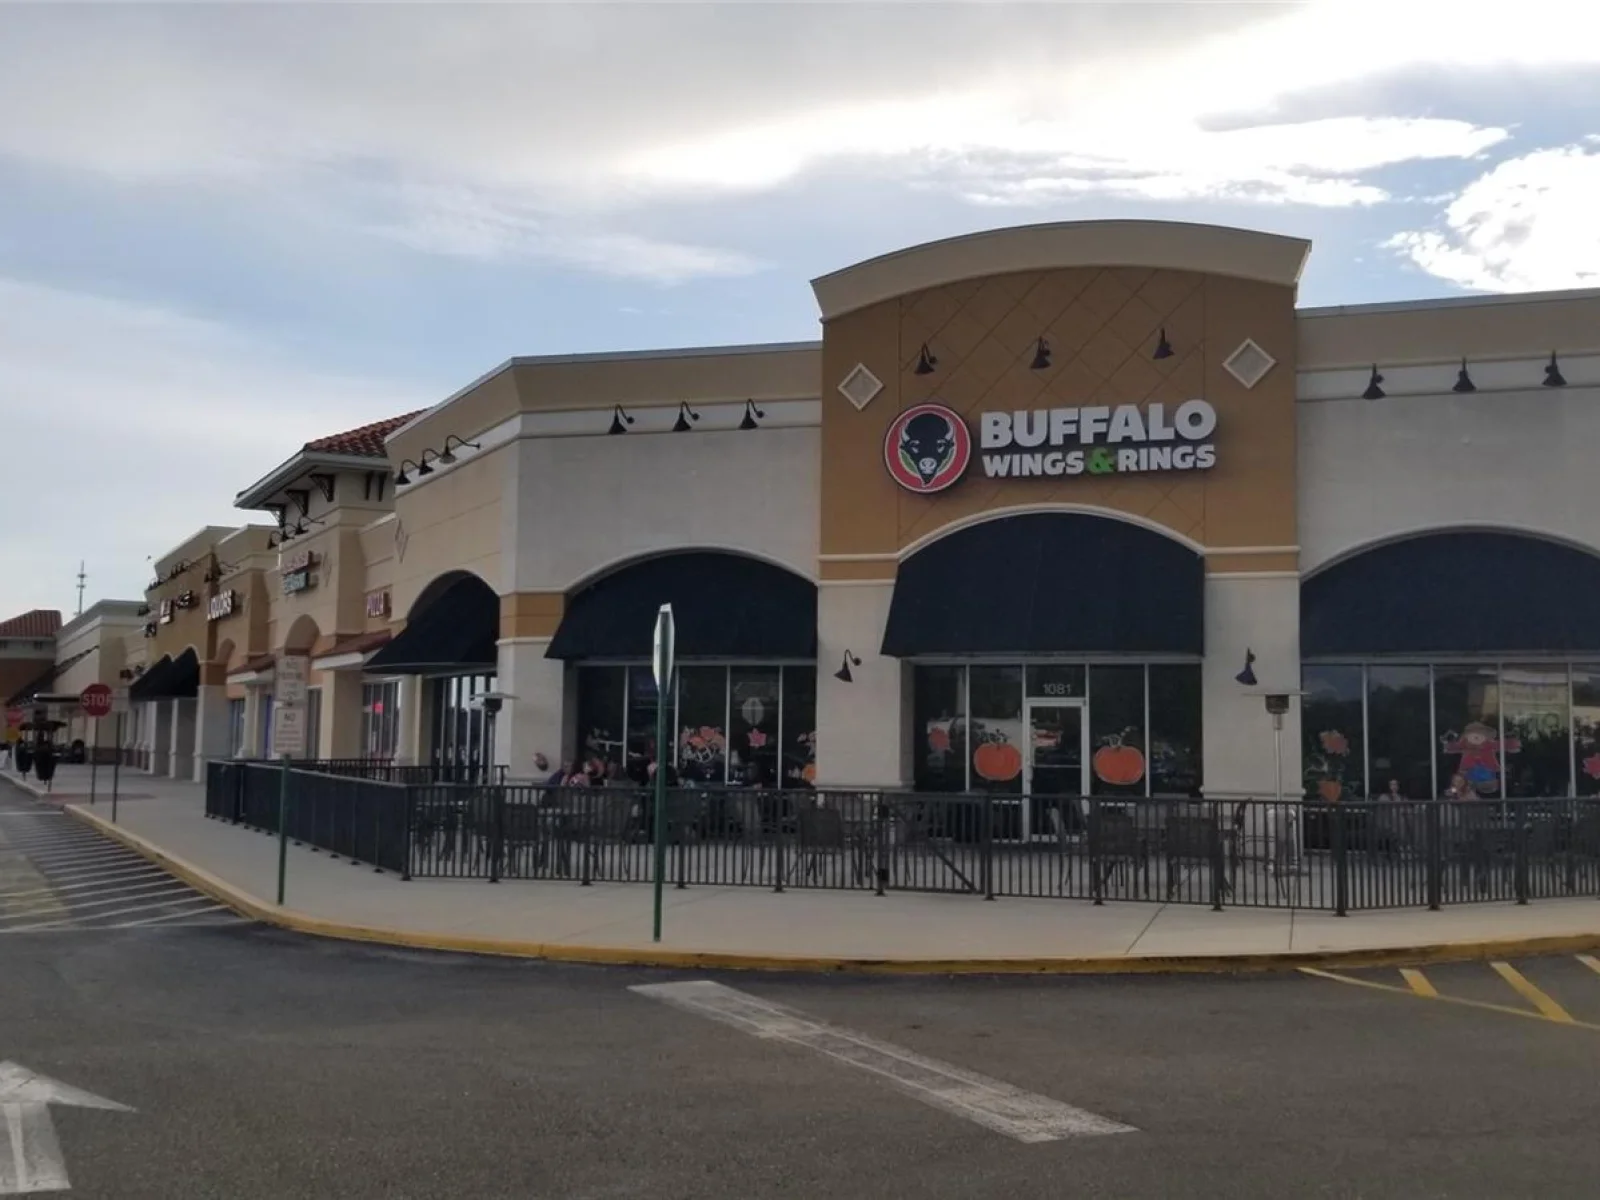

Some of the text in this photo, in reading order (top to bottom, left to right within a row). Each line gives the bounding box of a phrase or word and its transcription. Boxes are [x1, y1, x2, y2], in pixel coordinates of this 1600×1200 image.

[980, 399, 1217, 449] BUFFALO
[981, 444, 1216, 478] WINGS & RINGS
[83, 693, 112, 706] STOP
[1042, 683, 1071, 695] 1081
